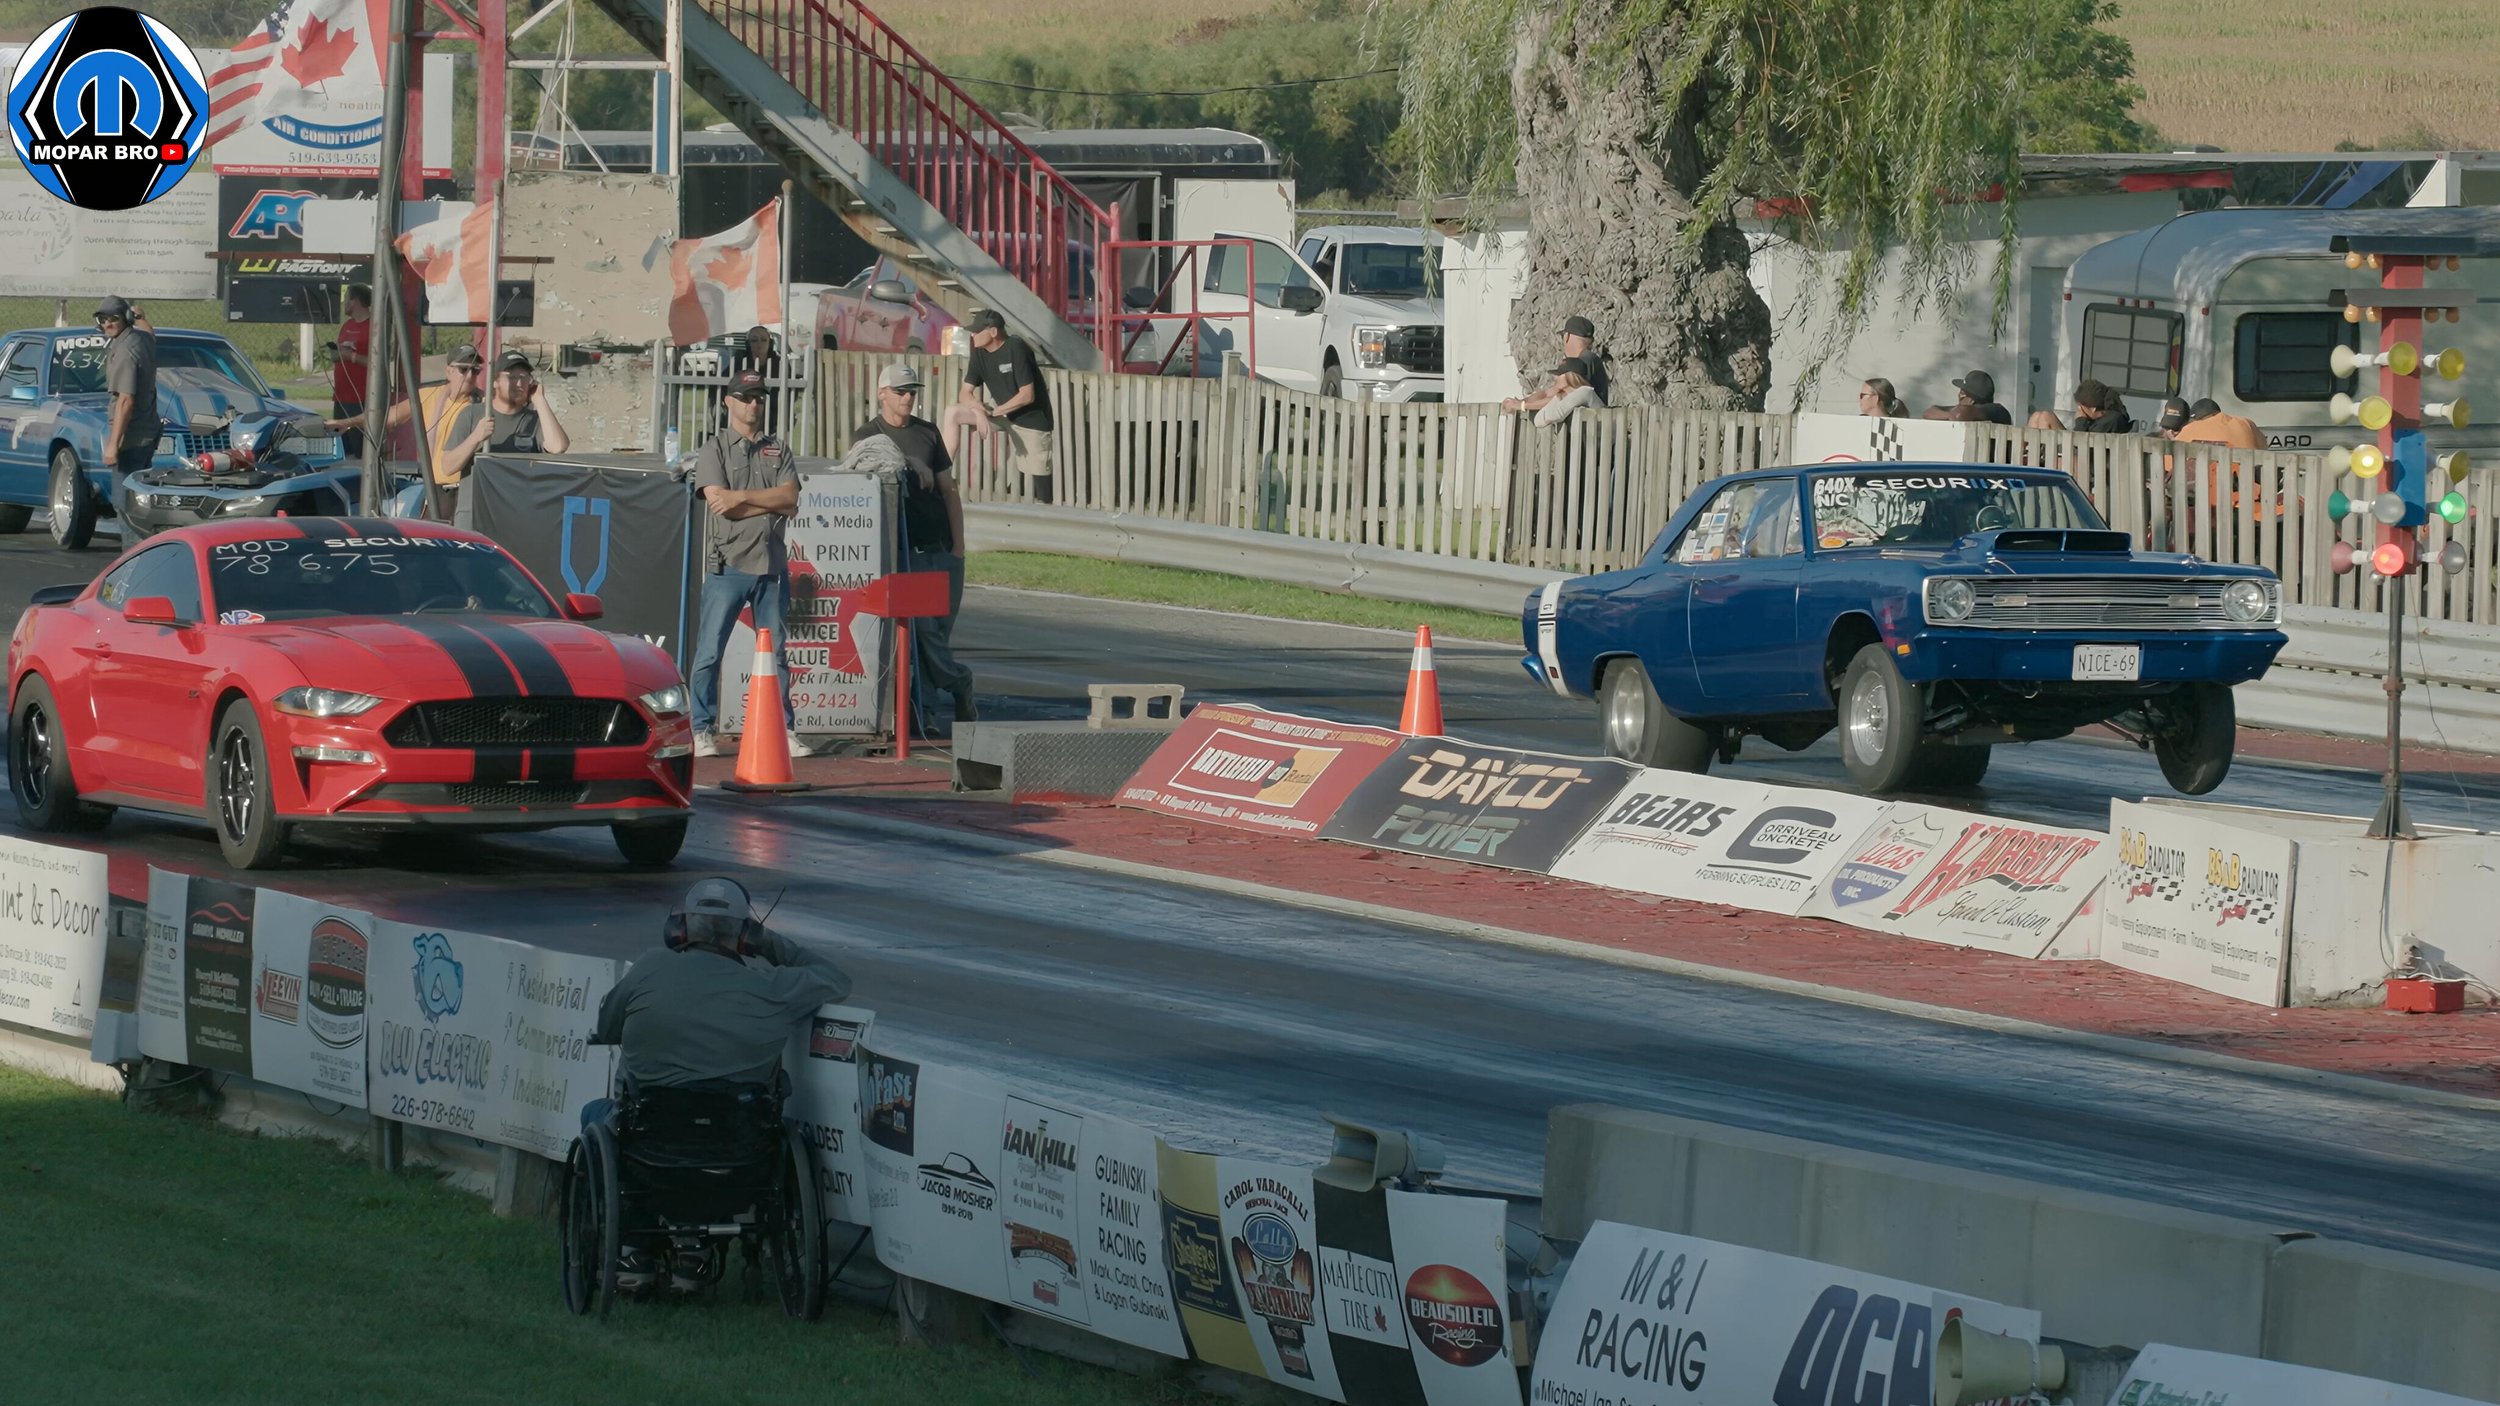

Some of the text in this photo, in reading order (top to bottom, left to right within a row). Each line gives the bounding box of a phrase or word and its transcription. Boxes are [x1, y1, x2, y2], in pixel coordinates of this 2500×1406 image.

[300, 122, 383, 145] CONDITIONIN
[2265, 434, 2312, 448] ARD
[808, 492, 873, 508] Monster
[787, 514, 873, 529] rint Media
[215, 541, 289, 555] MOD
[215, 552, 401, 575] 78 6.75
[816, 544, 870, 562] PRINT
[789, 624, 838, 641] RVICE
[828, 716, 870, 732] London
[1399, 748, 1592, 811] DAYCO
[1371, 802, 1520, 857] POWER
[1607, 792, 1737, 838] BEARS
[1854, 841, 1926, 871] LUCAS
[2147, 845, 2186, 878] RADIATOR
[1850, 869, 1900, 889] PRODUCTS
[2240, 866, 2280, 900] RADIATOR
[31, 882, 44, 926] &
[50, 887, 100, 937] Decor
[518, 963, 591, 1012] Residential
[517, 1014, 589, 1063] Commercial
[415, 1028, 493, 1093] ELECTRIC
[390, 1093, 477, 1132] 226-978-6642
[1039, 1136, 1077, 1172] HILL
[1095, 1154, 1146, 1195] GUBINSKI
[920, 1178, 952, 1200] JACOB
[953, 1187, 994, 1213] MOSHER
[1100, 1192, 1141, 1229] FAMILY
[1224, 1177, 1309, 1223] CAROL VARACALLI
[1098, 1226, 1147, 1266] RACING
[1365, 1267, 1394, 1301] CITY
[1620, 1246, 1665, 1306] M
[1656, 1253, 1687, 1311] &
[1102, 1285, 1128, 1311] Logan
[1128, 1295, 1169, 1322] Gubinski
[1341, 1298, 1372, 1332] TIRE
[1410, 1297, 1498, 1328] BEAUSOLEIL
[1428, 1321, 1483, 1349] Racing
[1576, 1307, 1709, 1393] RACING
[1541, 1378, 1588, 1406] Michael
